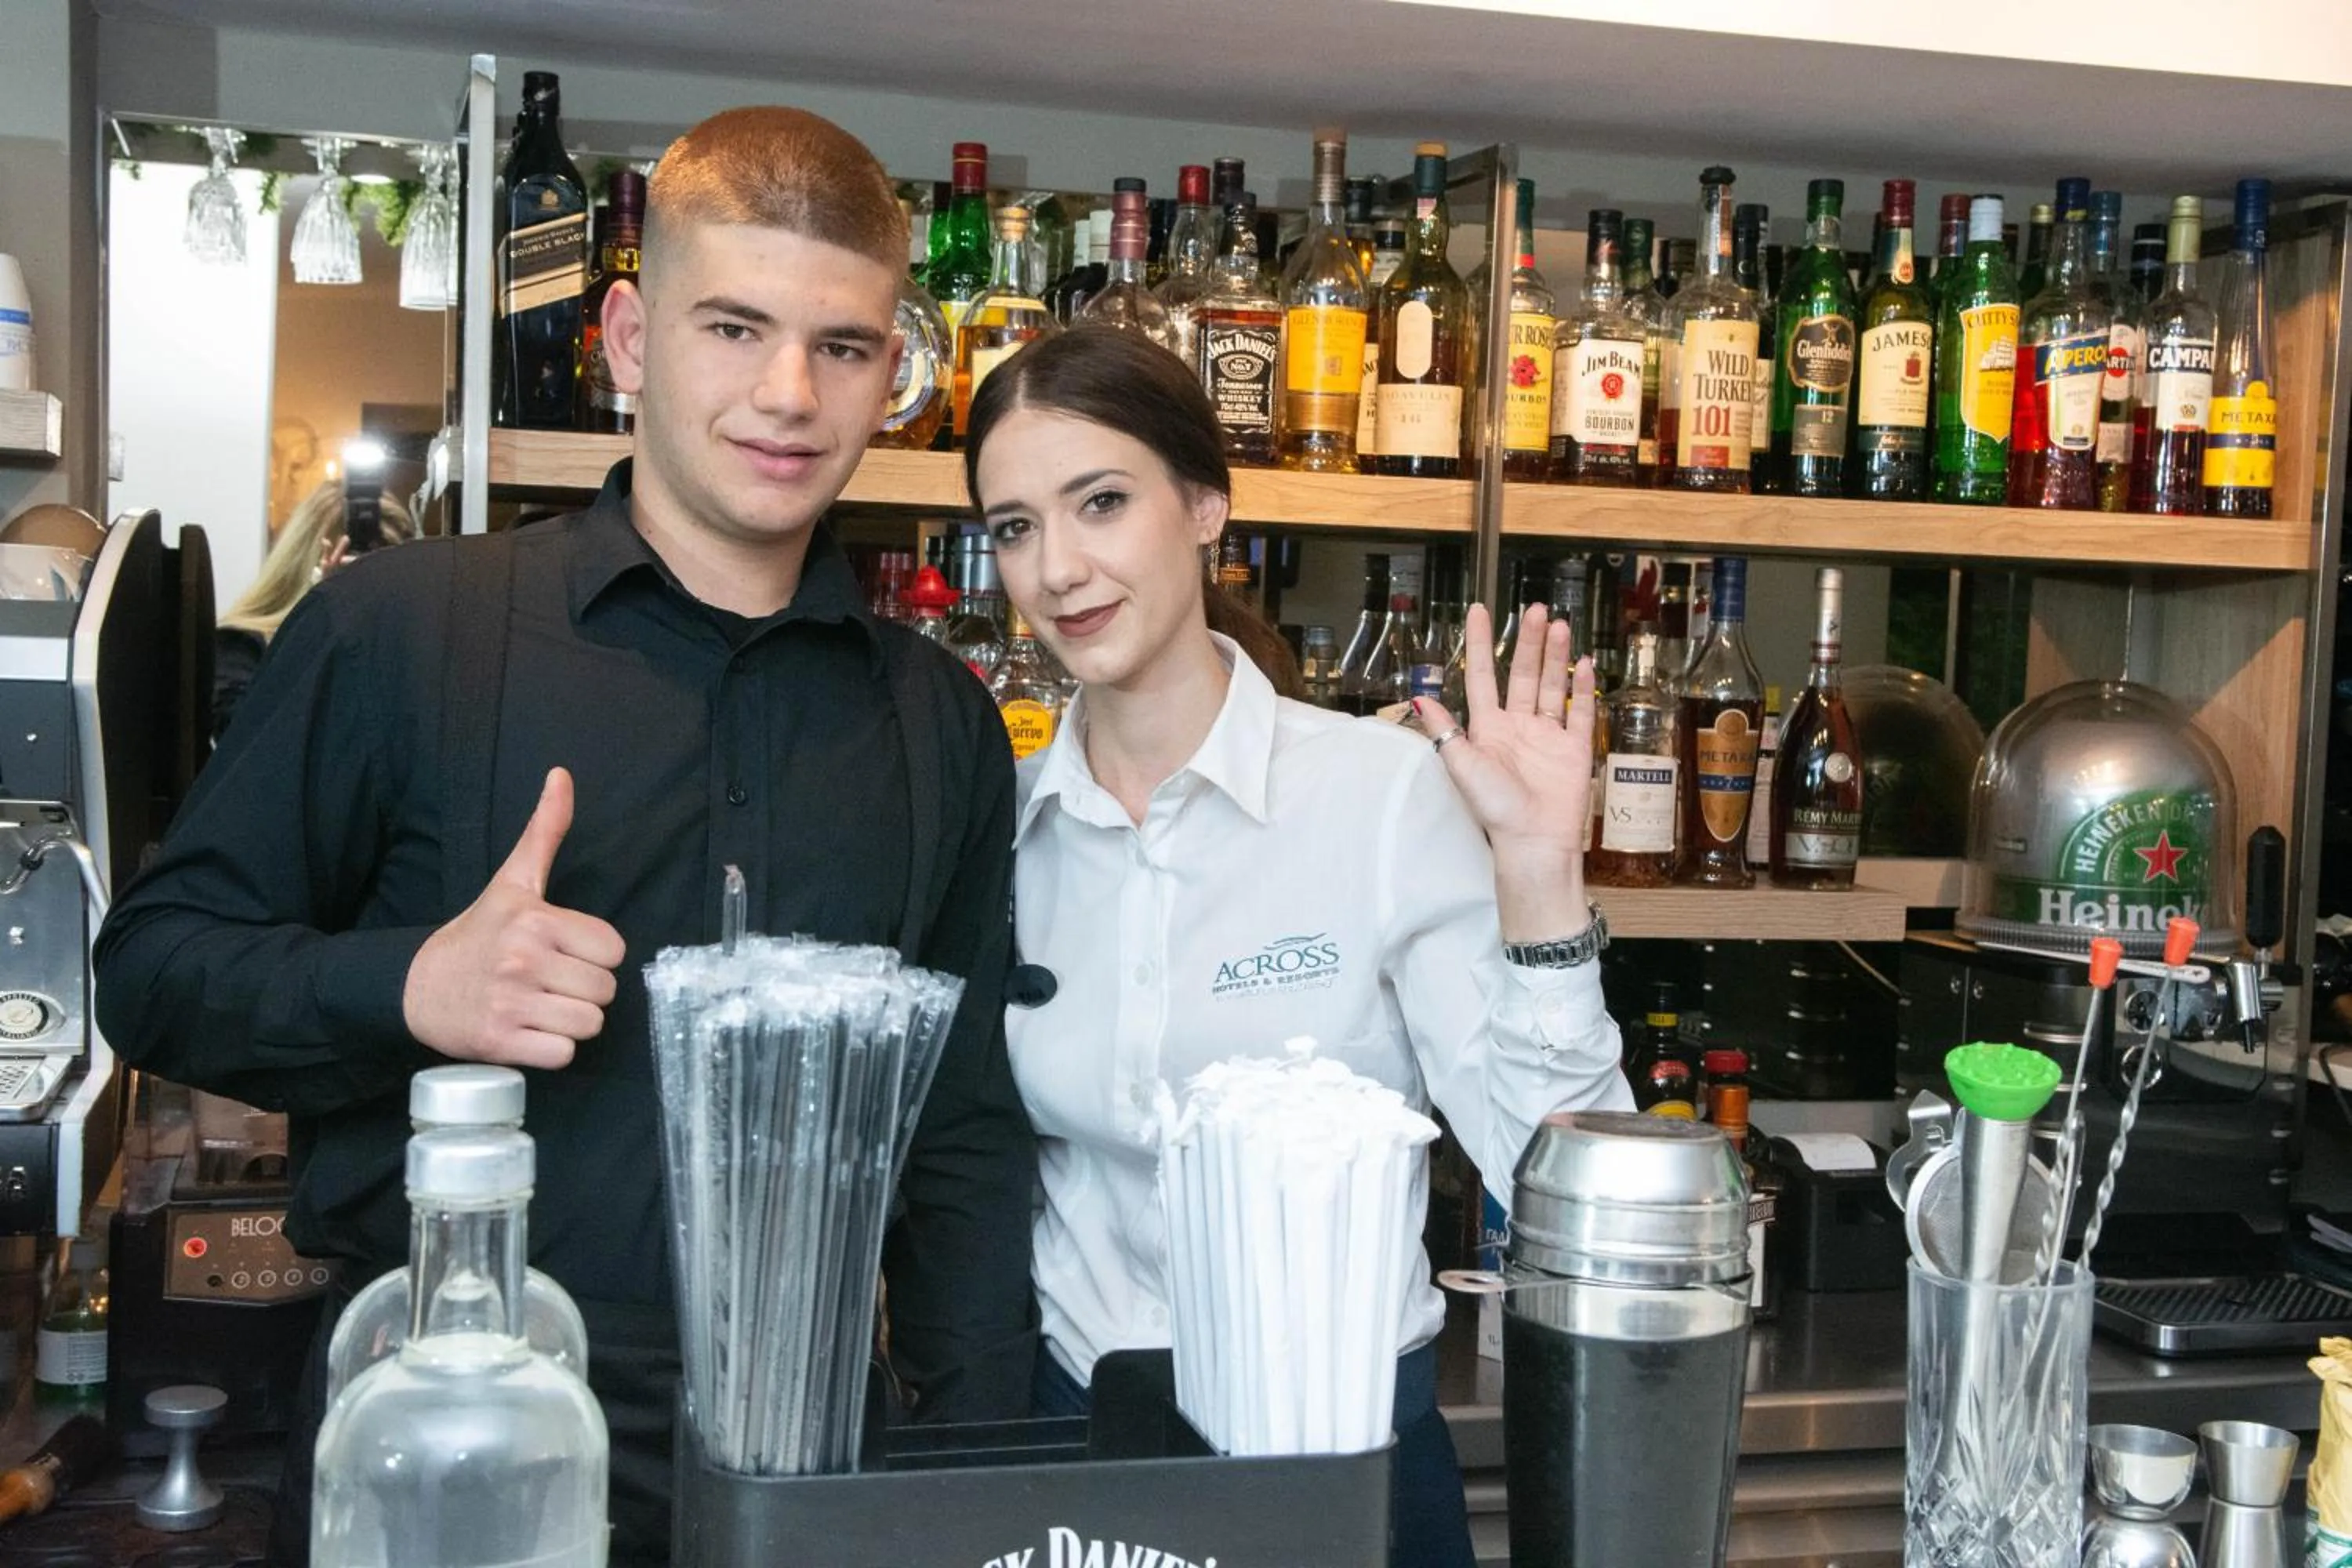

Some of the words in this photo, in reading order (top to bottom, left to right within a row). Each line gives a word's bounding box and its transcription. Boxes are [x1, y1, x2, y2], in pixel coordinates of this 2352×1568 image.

[1207, 337, 1235, 360] JACK
[2149, 347, 2213, 370] CAMPA
[1581, 355, 1606, 376] JIM
[1708, 350, 1749, 377] WILD
[1693, 374, 1751, 402] TURKE
[1584, 416, 1635, 431] BOURBON
[1693, 405, 1732, 437] 101
[1617, 770, 1671, 782] MARTELL
[2074, 800, 2161, 874] HEINEKEN
[1215, 942, 1340, 983] ACROSS
[1212, 978, 1259, 995] HOTELS
[1263, 977, 1272, 985] &
[1276, 967, 1341, 985] RESORTS
